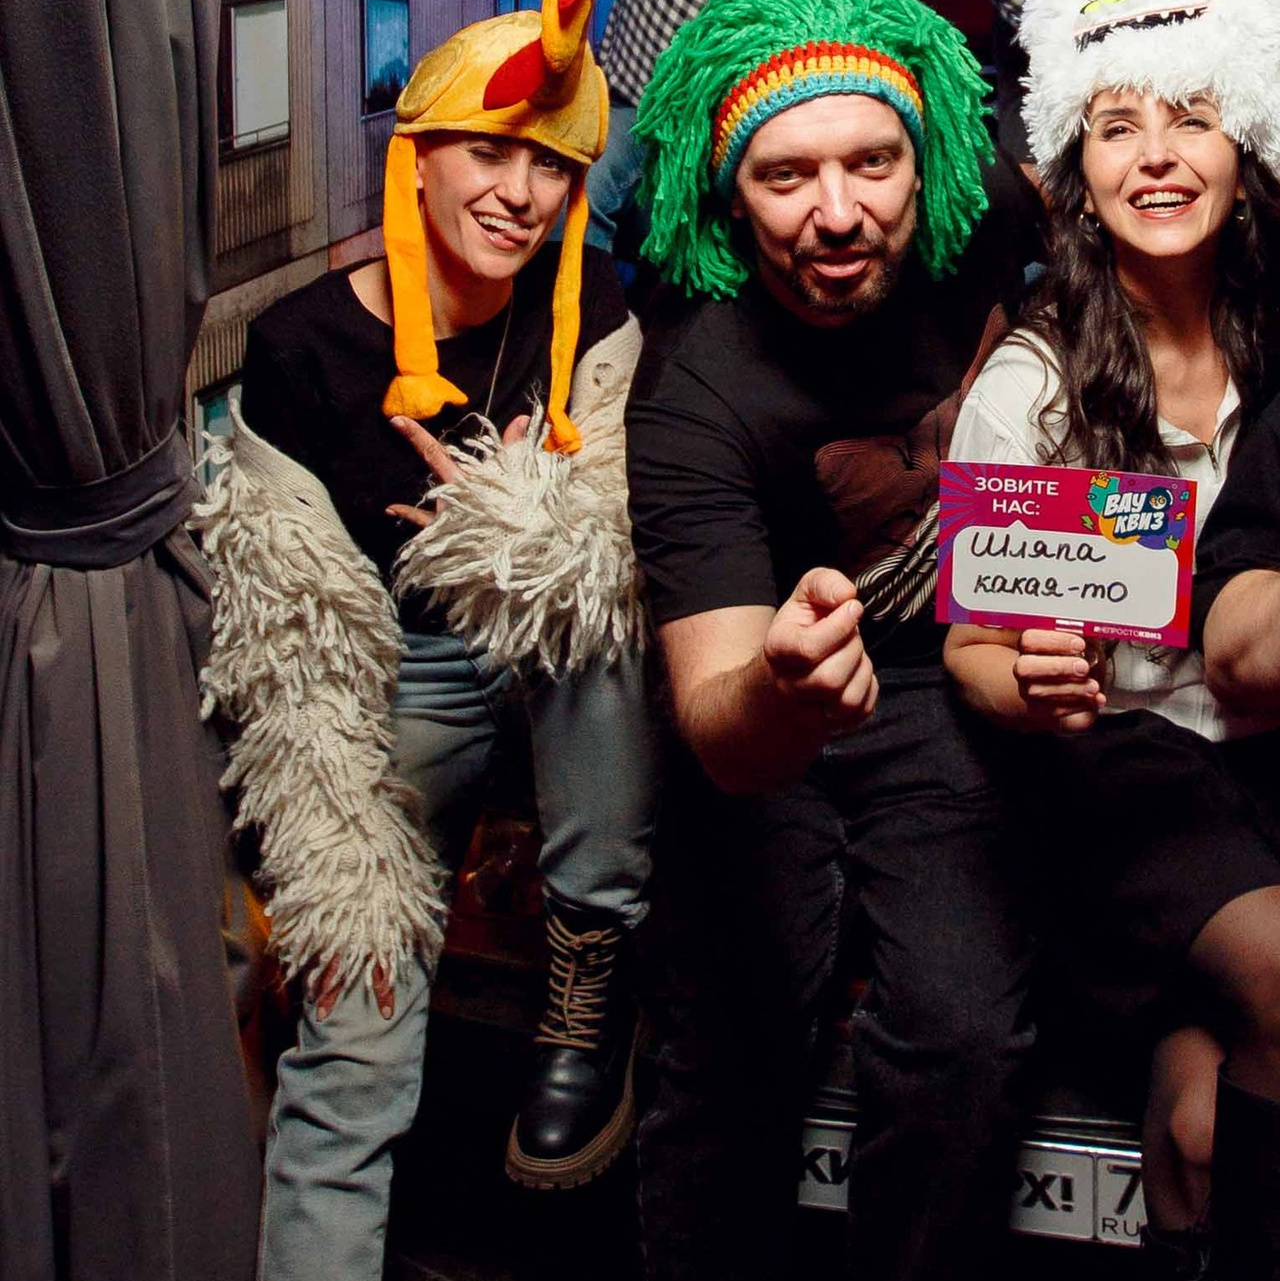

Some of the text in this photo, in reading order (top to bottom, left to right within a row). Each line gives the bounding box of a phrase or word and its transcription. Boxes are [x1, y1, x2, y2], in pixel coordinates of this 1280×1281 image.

[973, 476, 1060, 496] ЗОВИТЕ
[992, 498, 1041, 516] НАС:
[1103, 490, 1149, 517] ВАУ
[1114, 510, 1165, 534] КВИЗ
[970, 531, 1107, 563] Шляпа
